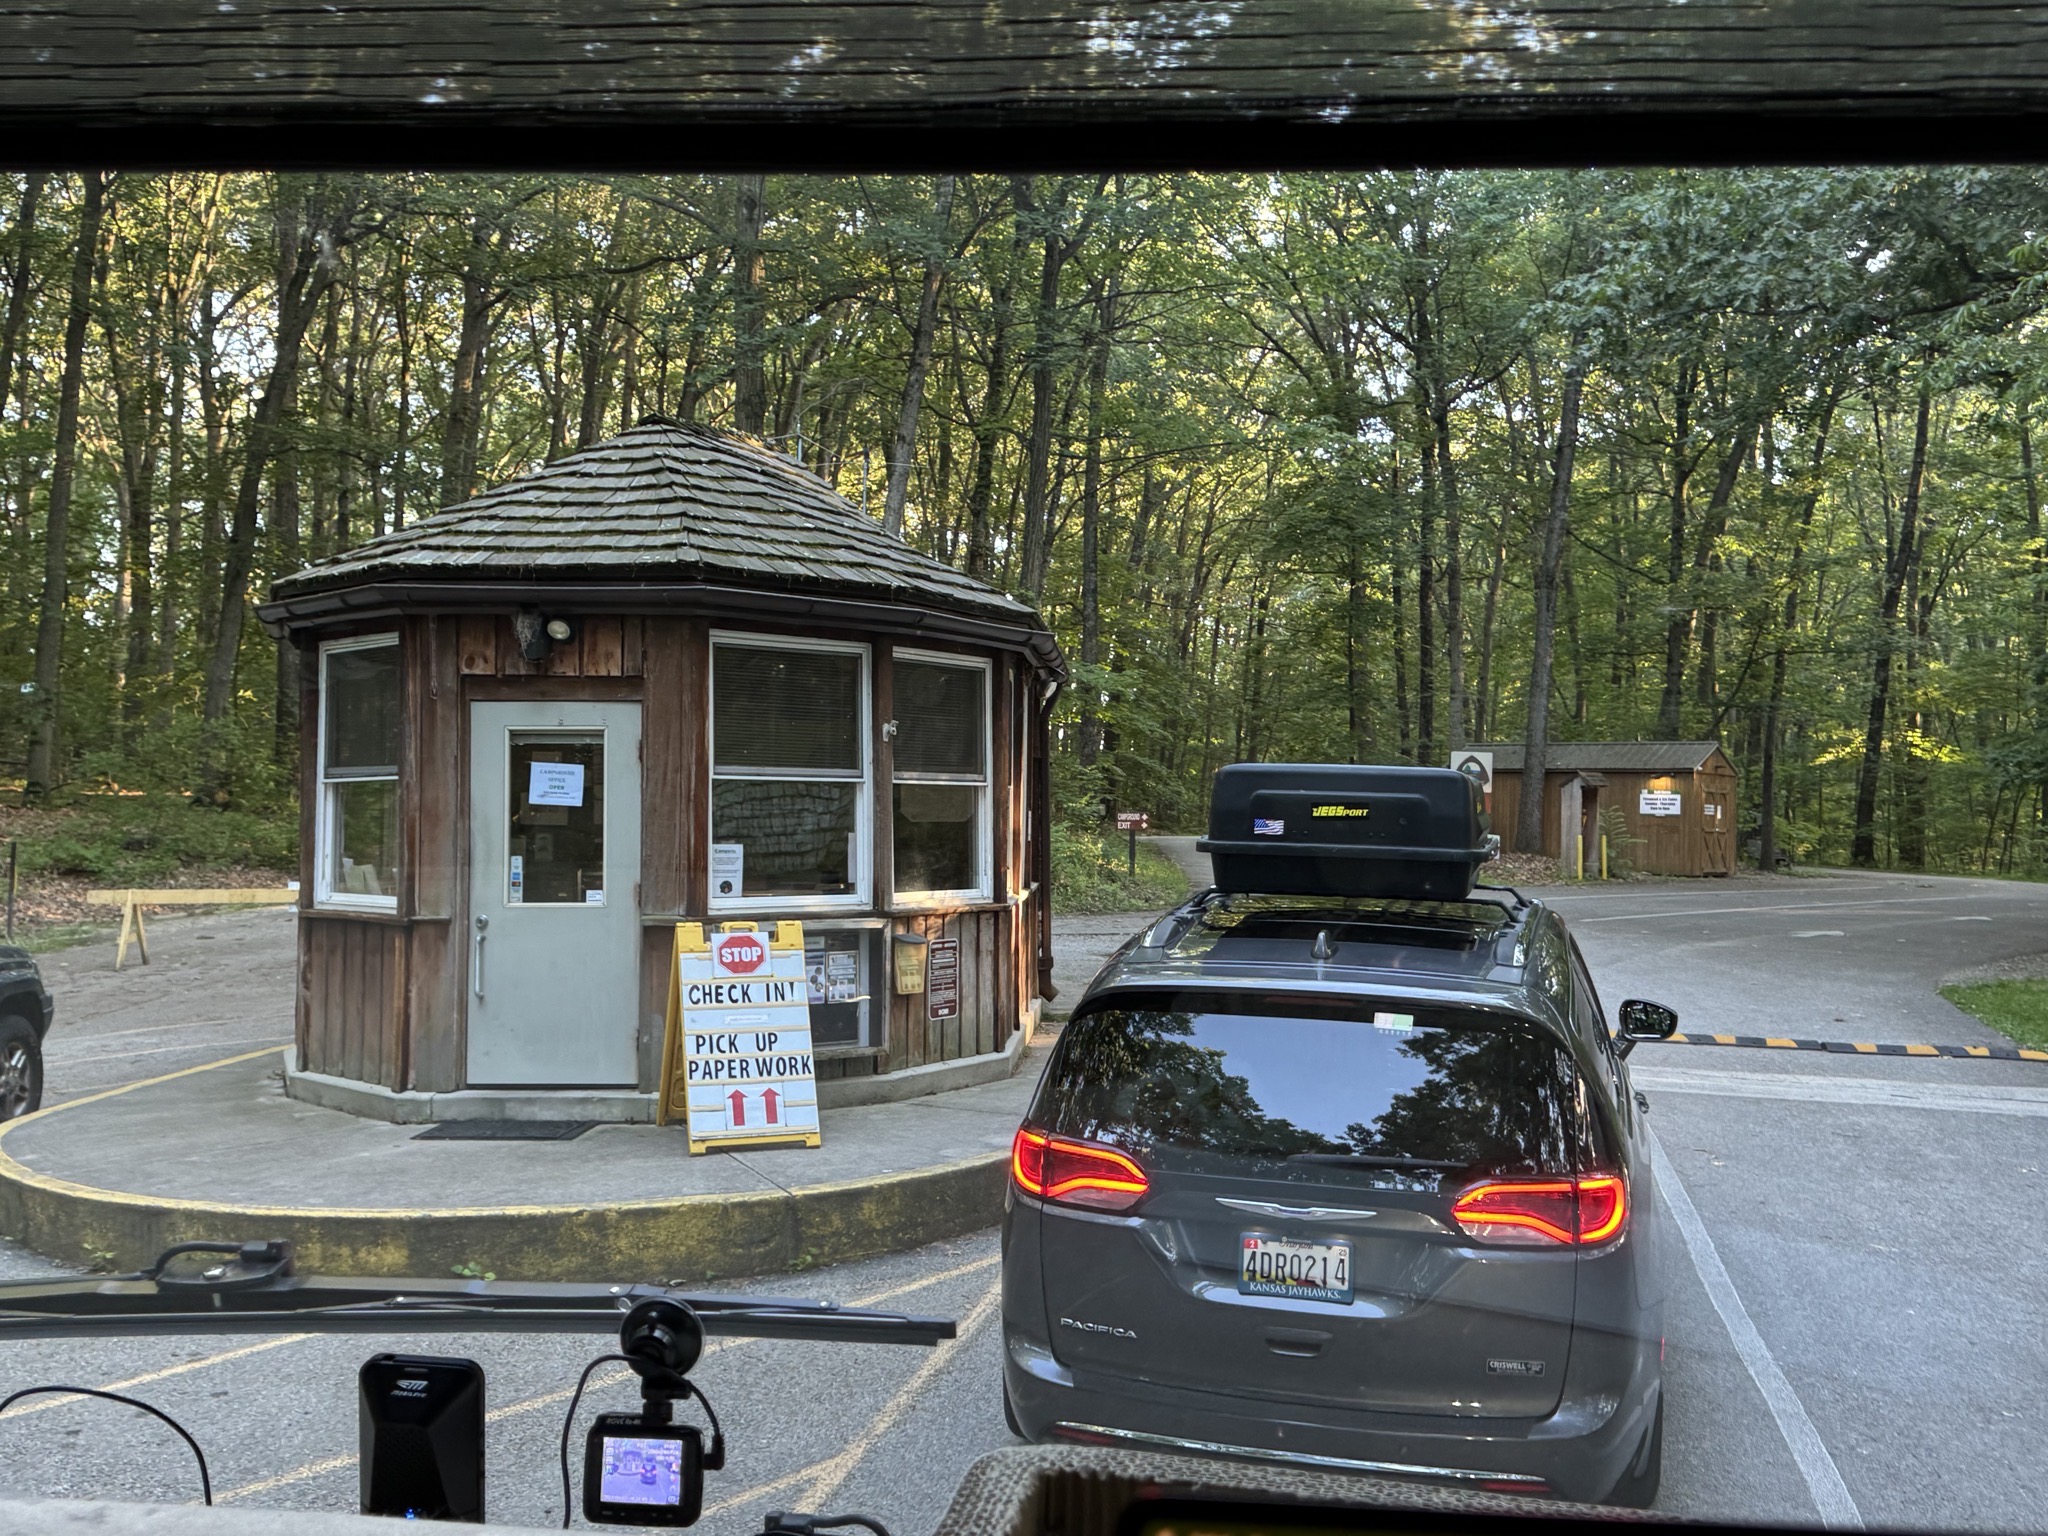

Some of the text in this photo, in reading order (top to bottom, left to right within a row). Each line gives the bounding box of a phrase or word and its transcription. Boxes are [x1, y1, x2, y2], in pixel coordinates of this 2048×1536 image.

[1118, 821, 1131, 829] EXIT
[721, 947, 762, 963] STOP
[688, 981, 796, 1005] CHECK IN!
[695, 1032, 778, 1054] PICK UP
[1338, 1248, 1347, 1257] 25
[1249, 1282, 1286, 1293] KANSAS
[1060, 1317, 1137, 1339] PACIFICA
[1489, 1361, 1526, 1370] CRISWELL
